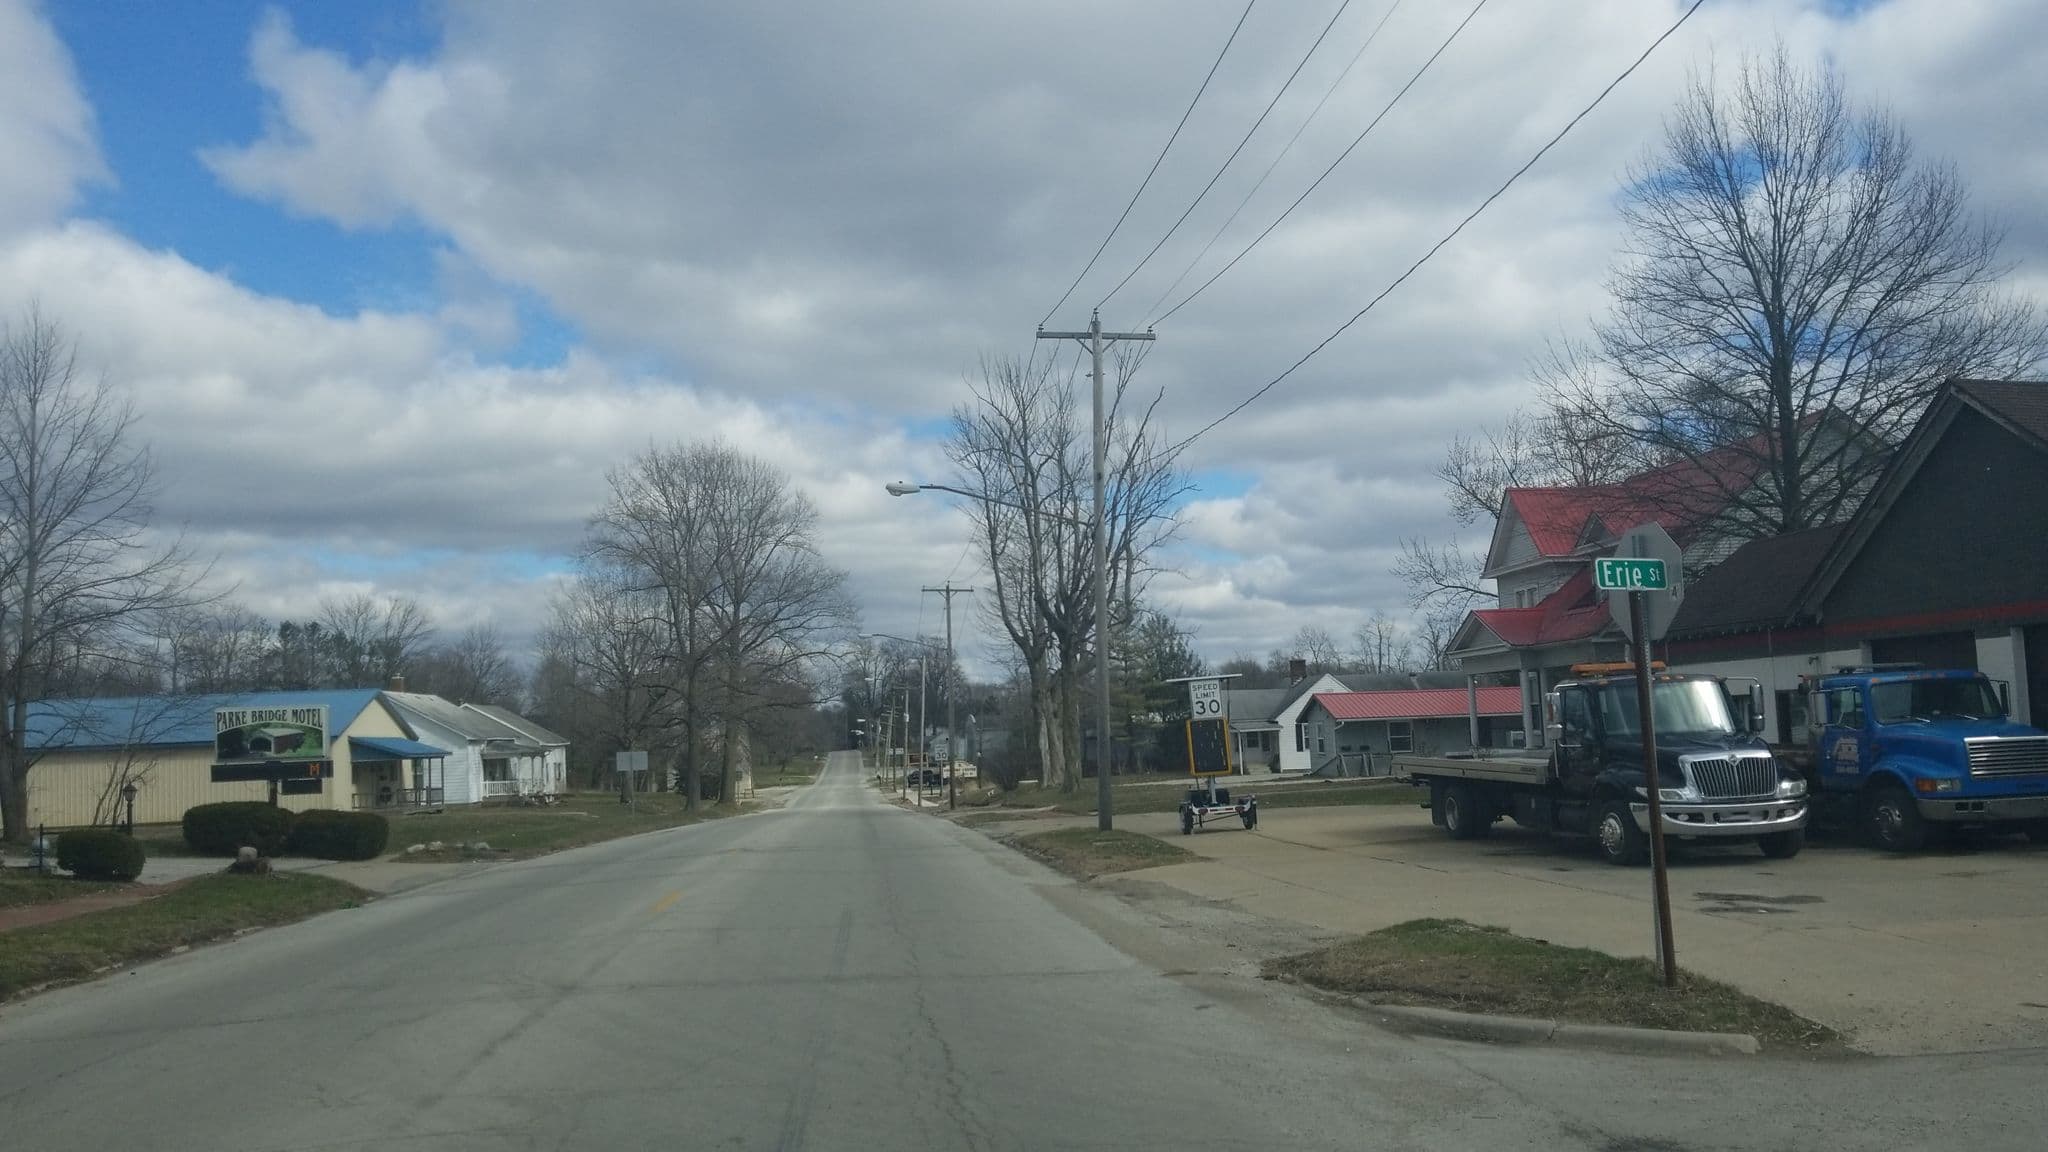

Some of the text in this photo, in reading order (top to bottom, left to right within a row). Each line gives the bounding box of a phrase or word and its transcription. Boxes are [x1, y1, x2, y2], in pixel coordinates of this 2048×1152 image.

[1602, 561, 1661, 586] Erie St
[1192, 683, 1217, 692] SPEED
[1195, 691, 1215, 699] LIMIT
[1195, 699, 1220, 715] 30
[216, 708, 323, 732] PARKE BRIDGE MOTEL
